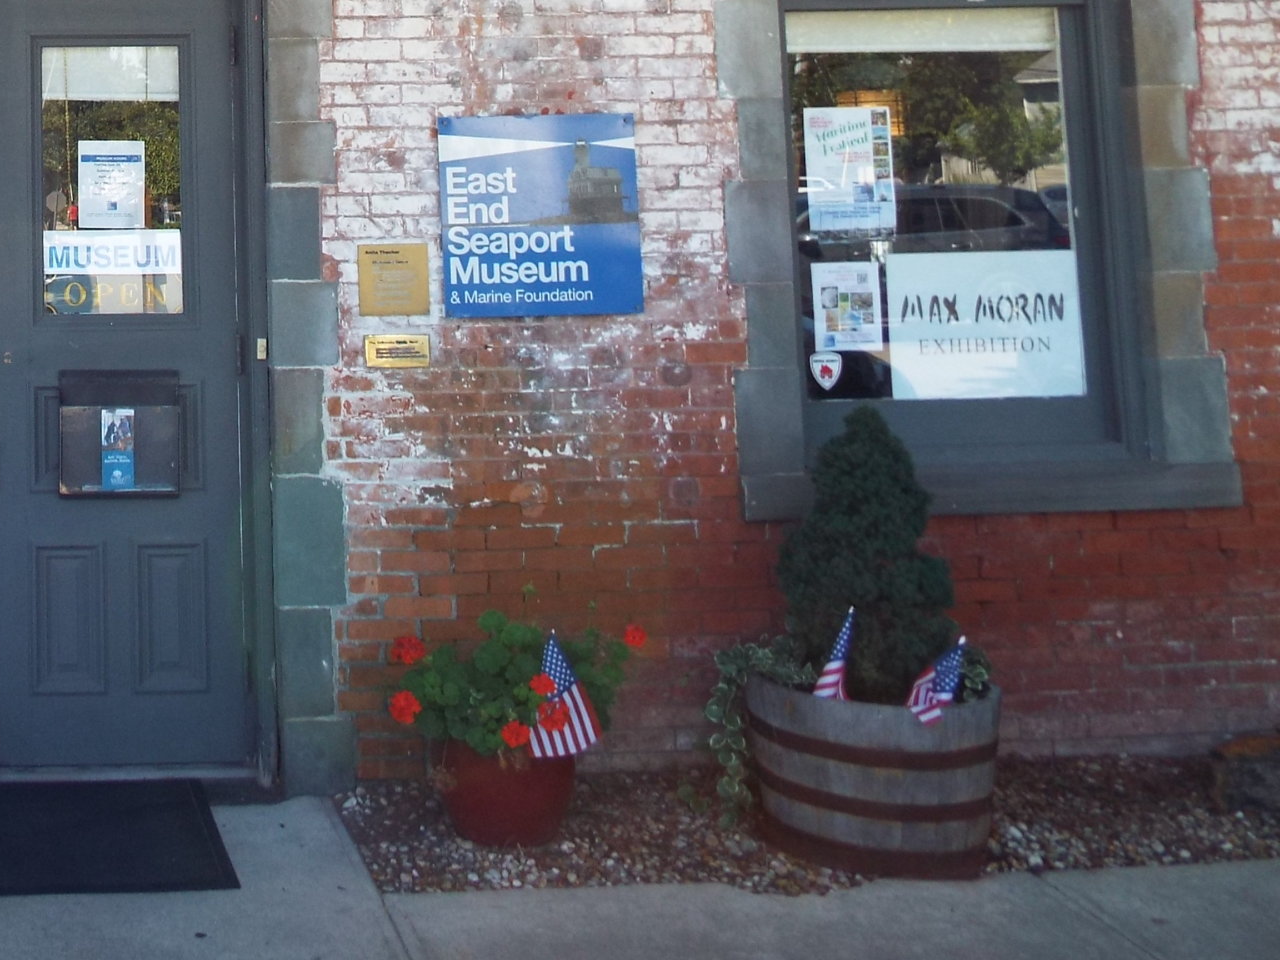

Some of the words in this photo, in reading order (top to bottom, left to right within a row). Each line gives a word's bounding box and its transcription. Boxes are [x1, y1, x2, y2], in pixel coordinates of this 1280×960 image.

[445, 166, 517, 195] East
[446, 195, 510, 225] End
[48, 244, 177, 270] MUSEUM
[447, 225, 575, 260] Seaport
[449, 256, 590, 285] Museum
[63, 281, 168, 307] OPEN
[449, 290, 462, 305] &
[464, 289, 512, 304] Marine
[515, 287, 594, 303] Foundation
[901, 293, 959, 324] MAX
[974, 292, 1065, 324] MORAN
[918, 335, 1052, 355] EXHIBITION
